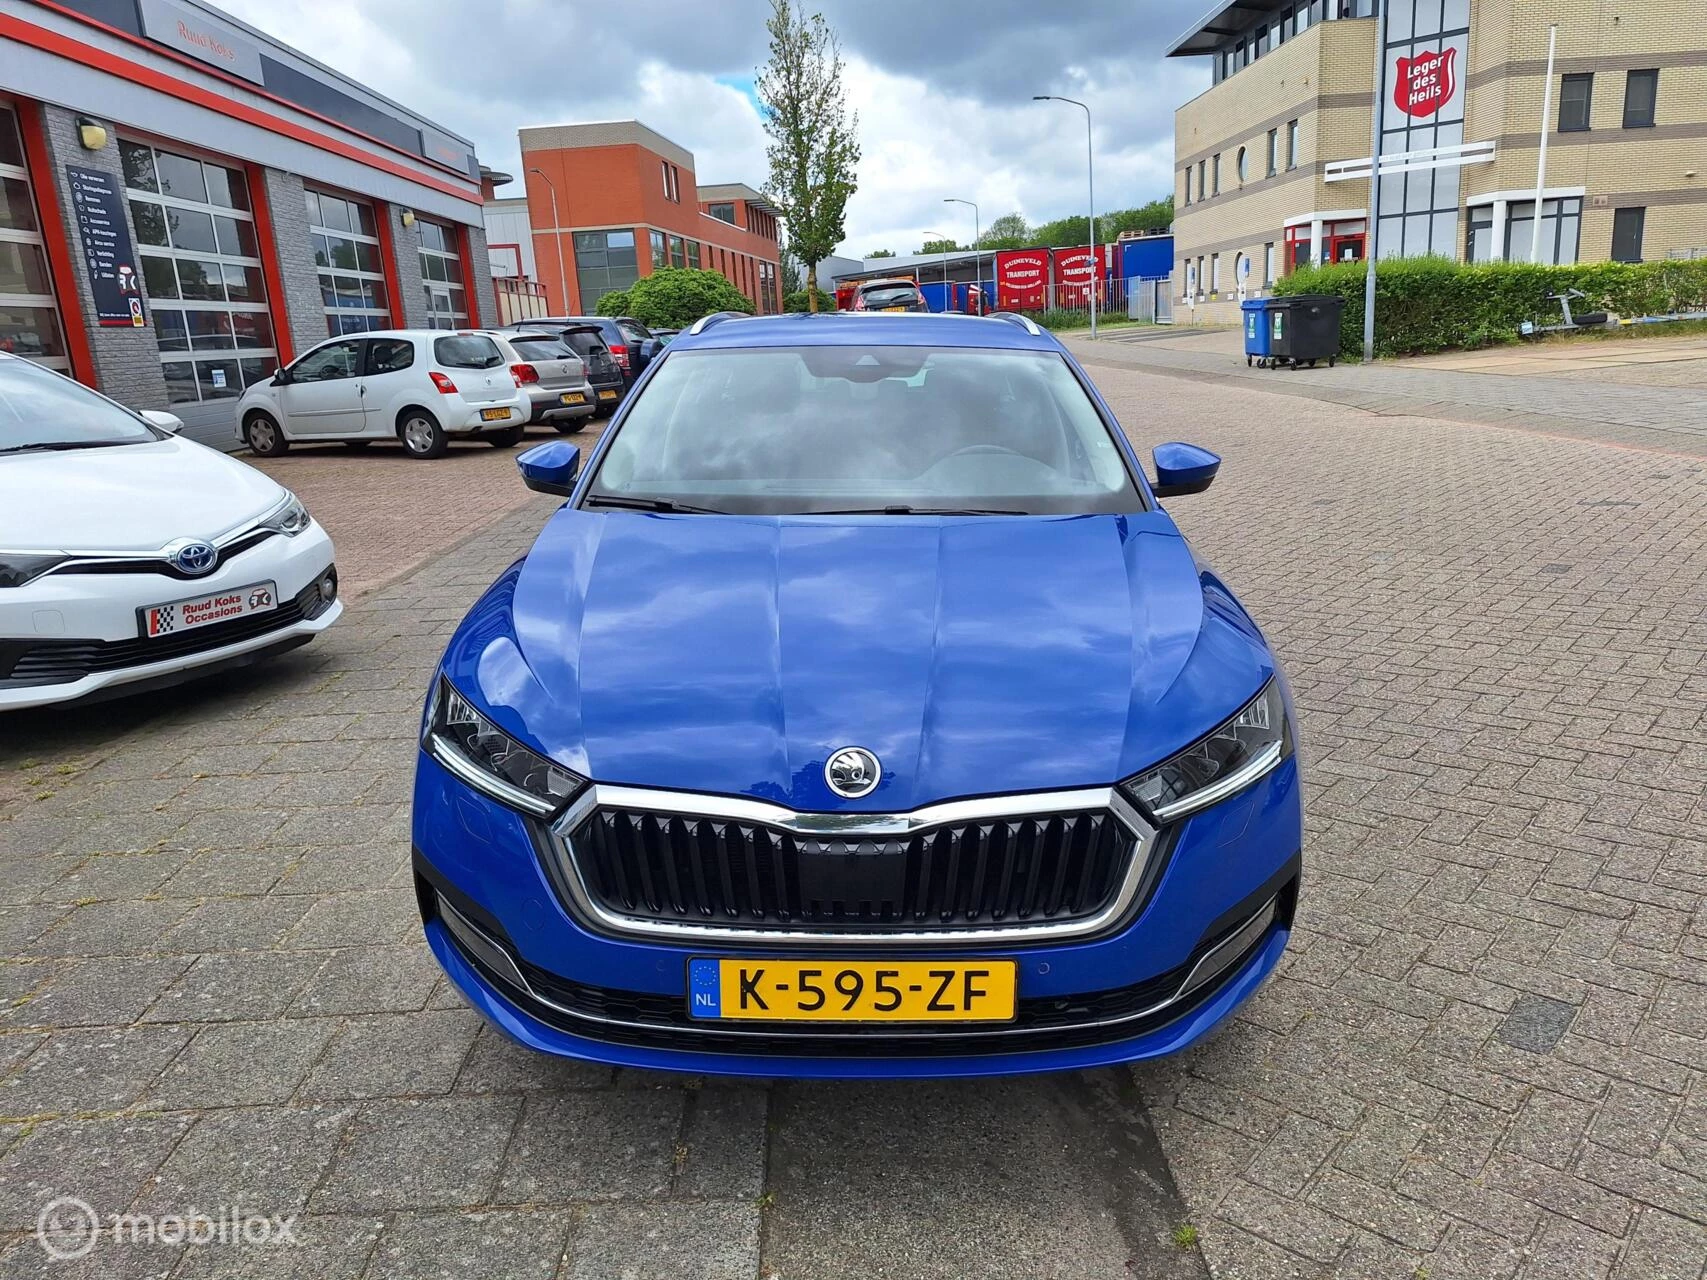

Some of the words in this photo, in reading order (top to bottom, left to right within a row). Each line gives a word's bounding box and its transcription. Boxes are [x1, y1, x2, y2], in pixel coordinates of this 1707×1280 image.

[1407, 55, 1444, 79] Leger
[1413, 73, 1437, 90] des
[1408, 85, 1442, 106] Heils
[1004, 257, 1042, 269] DUINEVELD
[1006, 269, 1040, 278] TRANSPORT
[182, 600, 212, 615] Ruud
[214, 595, 242, 608] Koks
[185, 605, 243, 625] Occasions
[695, 993, 717, 1007] NL
[739, 969, 990, 1012] K-595-ZF
